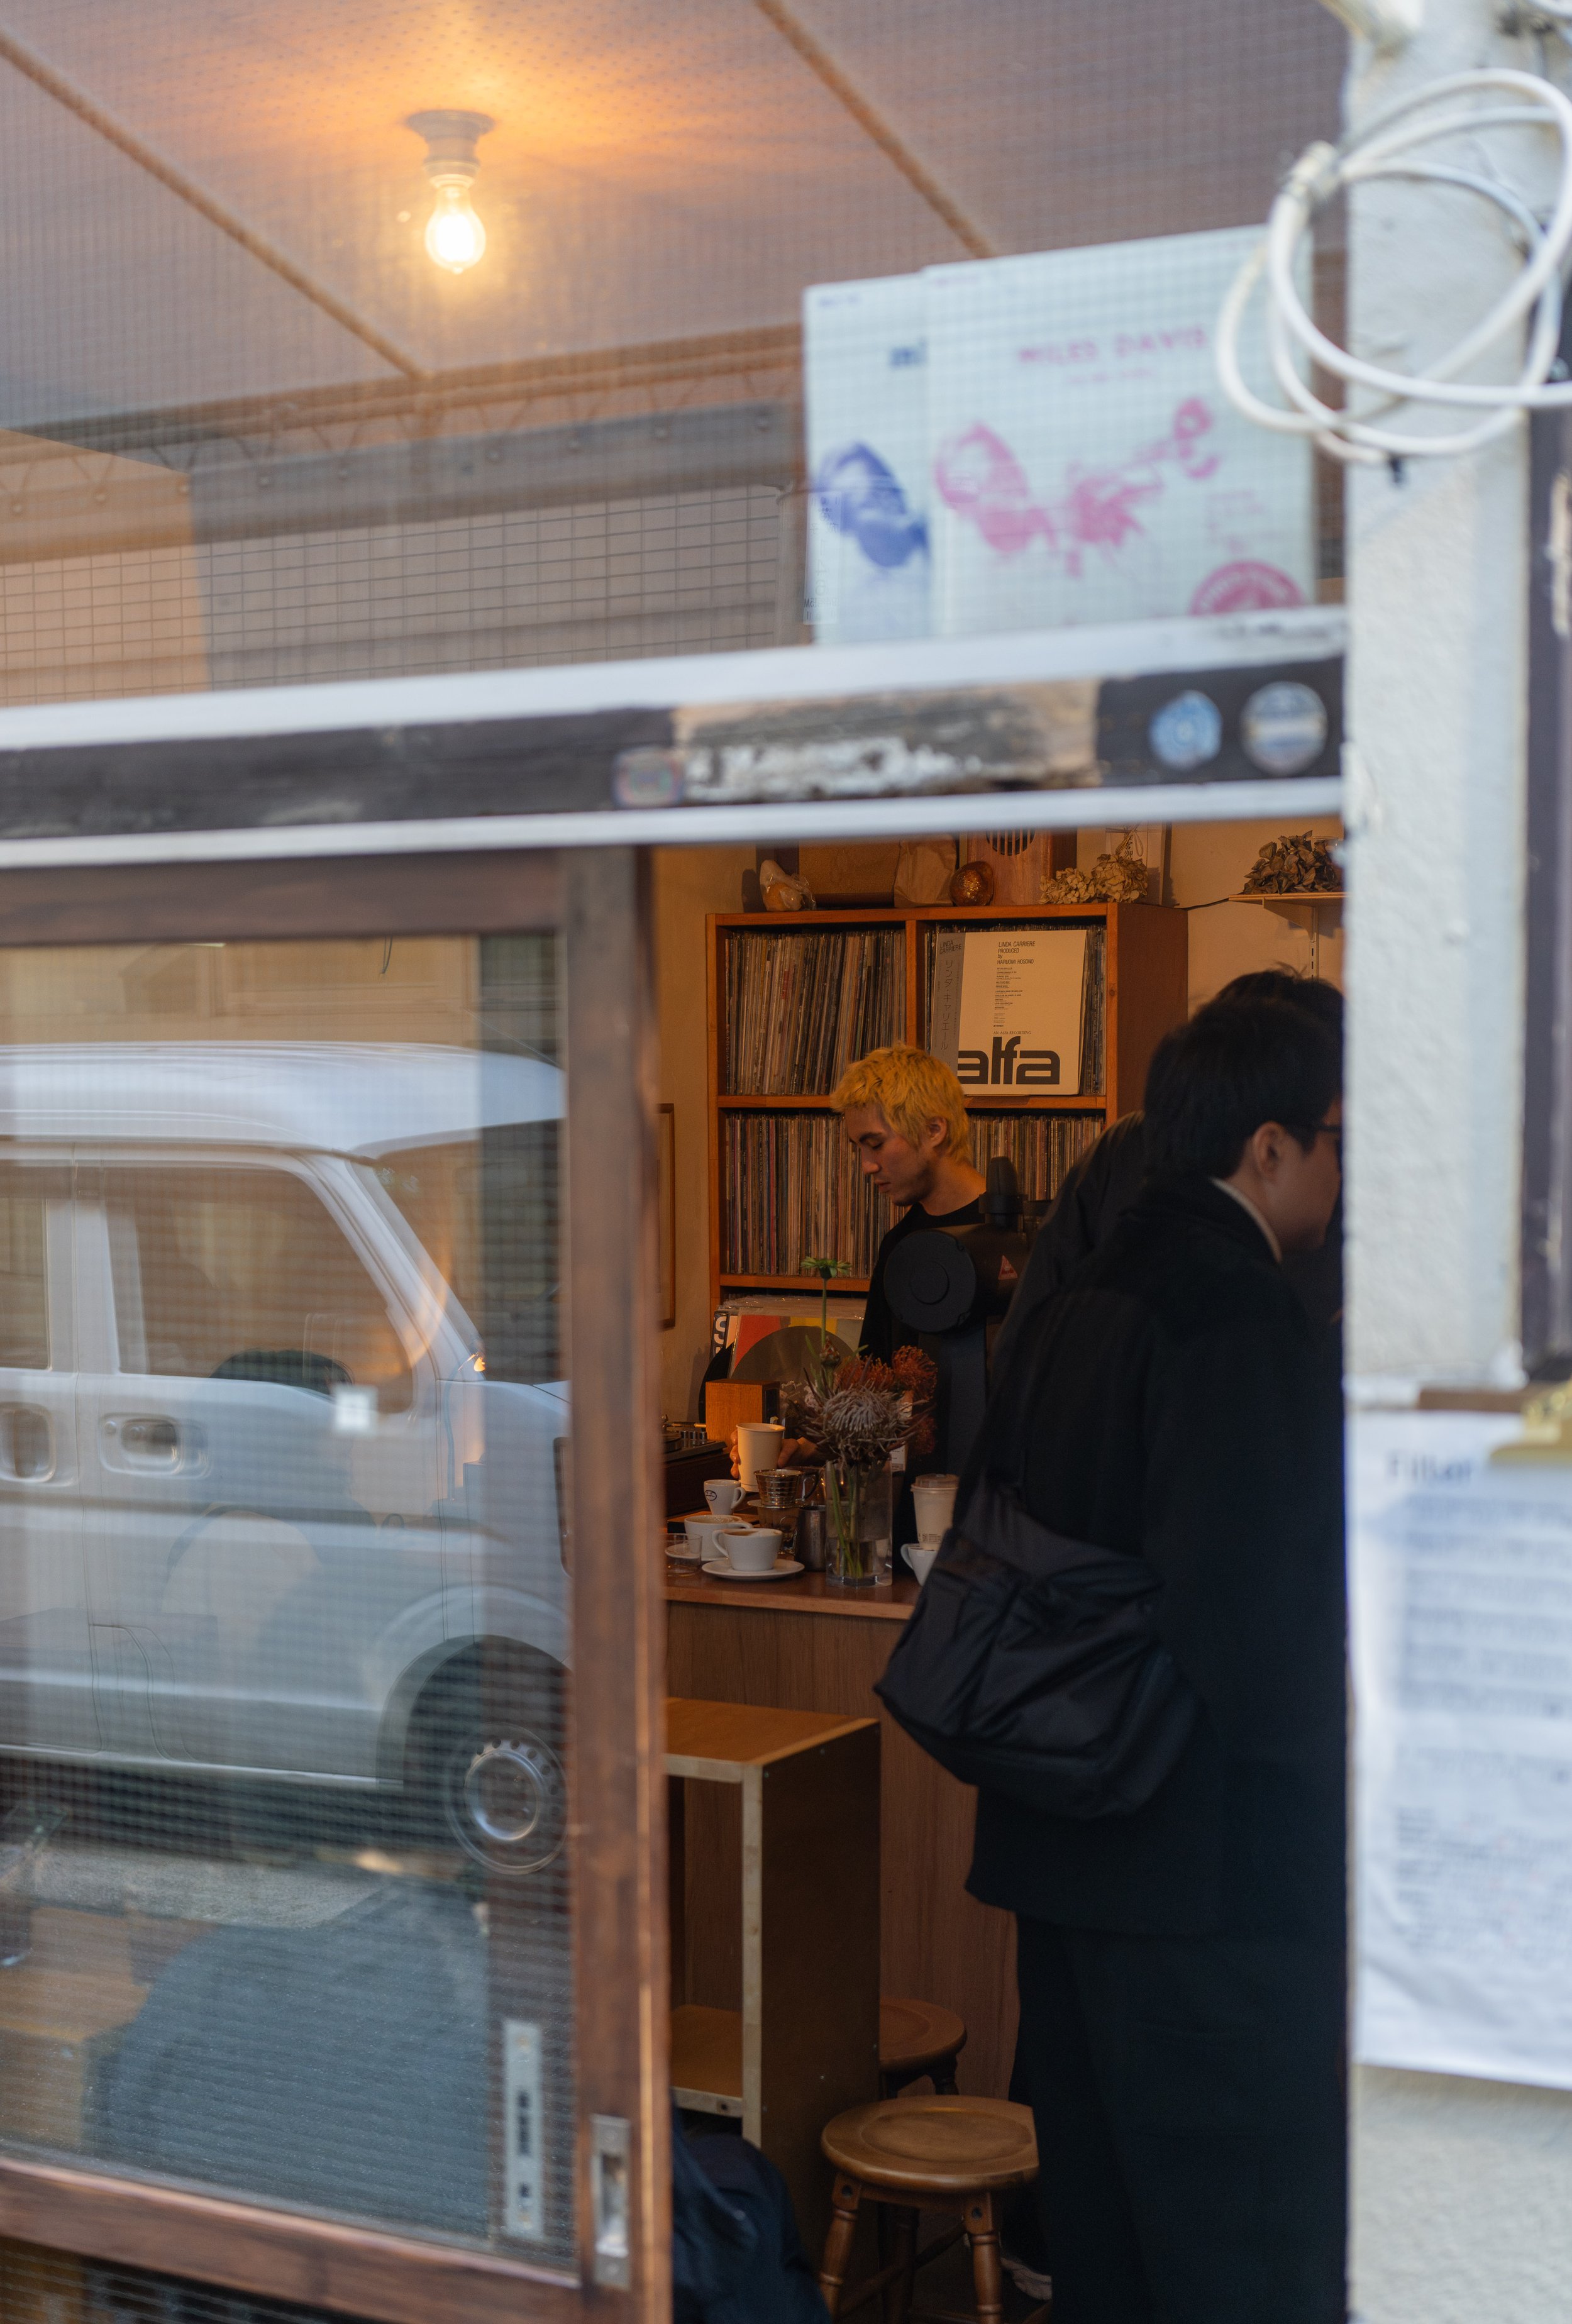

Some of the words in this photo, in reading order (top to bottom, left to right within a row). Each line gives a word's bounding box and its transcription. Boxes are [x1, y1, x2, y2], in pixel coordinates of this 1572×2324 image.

[939, 943, 961, 954] CARRIERE
[940, 940, 953, 948] LINDA
[941, 960, 954, 1050] リンダ・キャリエール
[958, 1036, 1060, 1085] alfa
